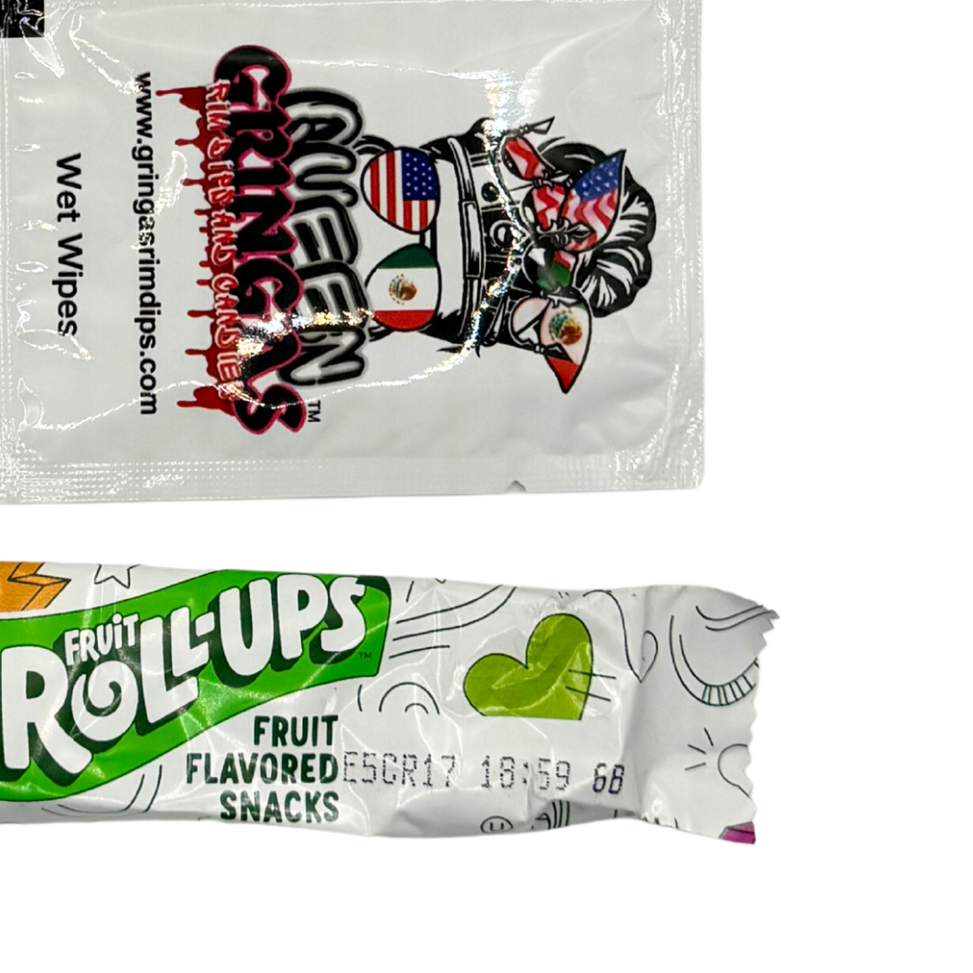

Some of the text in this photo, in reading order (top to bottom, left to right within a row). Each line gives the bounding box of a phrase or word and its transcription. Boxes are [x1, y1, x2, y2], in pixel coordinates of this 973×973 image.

[204, 80, 234, 131] RIM
[52, 153, 85, 337] Wet Wipes
[132, 71, 161, 415] www.gringasrimdips.com
[211, 209, 238, 266] AND
[214, 45, 307, 435] GRINGAS
[280, 88, 367, 387] QUEEN
[0, 575, 369, 782] ROLL-UPS
[254, 715, 338, 746] FRUIT
[187, 755, 338, 784] FLAVORED
[220, 792, 340, 822] SNACKS
